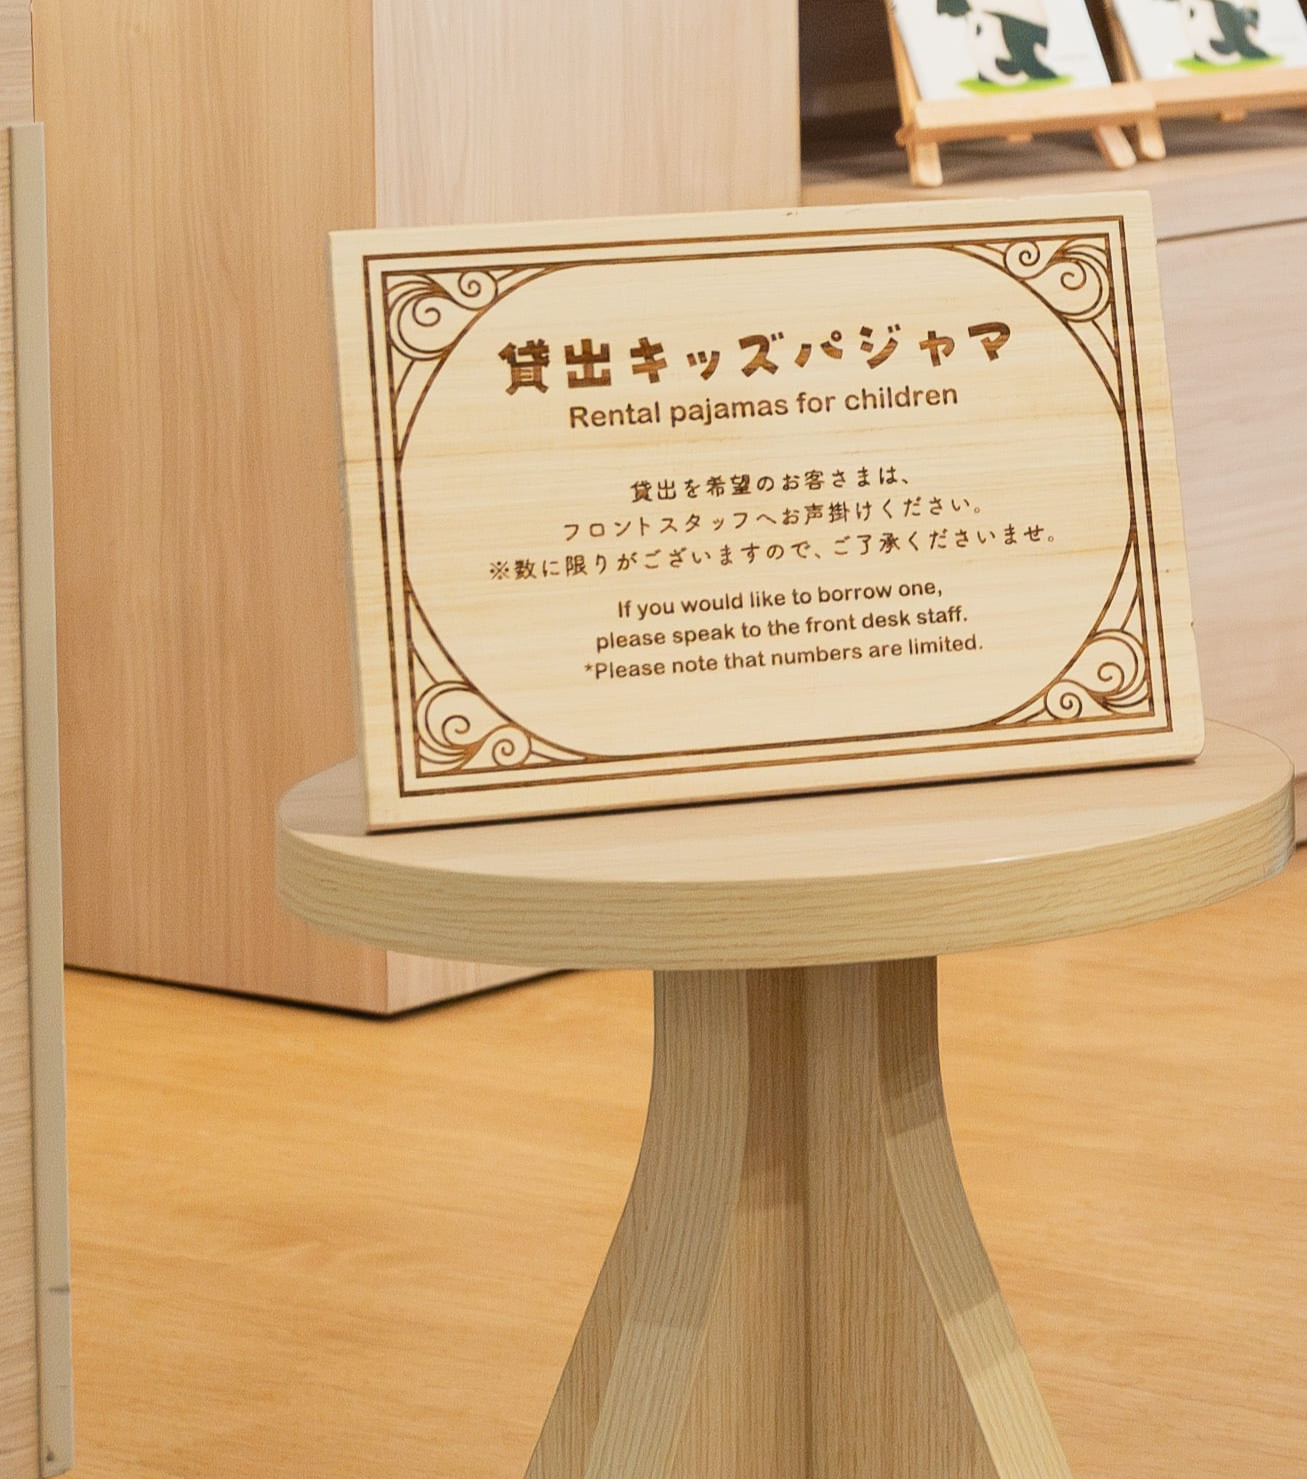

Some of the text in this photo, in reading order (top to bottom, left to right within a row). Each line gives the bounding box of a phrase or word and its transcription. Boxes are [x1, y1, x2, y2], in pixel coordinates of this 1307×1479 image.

[497, 321, 1011, 396] 貸出キッズパジャマ
[569, 384, 958, 430] Rental pajamas for children
[629, 465, 909, 504] 貸出を希望のお客さまは、
[563, 495, 981, 542] フロントスタッフへお声掛けください。
[489, 523, 1055, 581] ※数に限りがございますので、ご了承くださいませ。
[617, 581, 943, 622] If you would like to borrow one,
[596, 604, 968, 654] please speak to the front desk staff.
[672, 655, 718, 674] note
[723, 650, 767, 670] that
[770, 645, 863, 667] numbers
[868, 643, 903, 659] are
[908, 633, 983, 656] limited.
